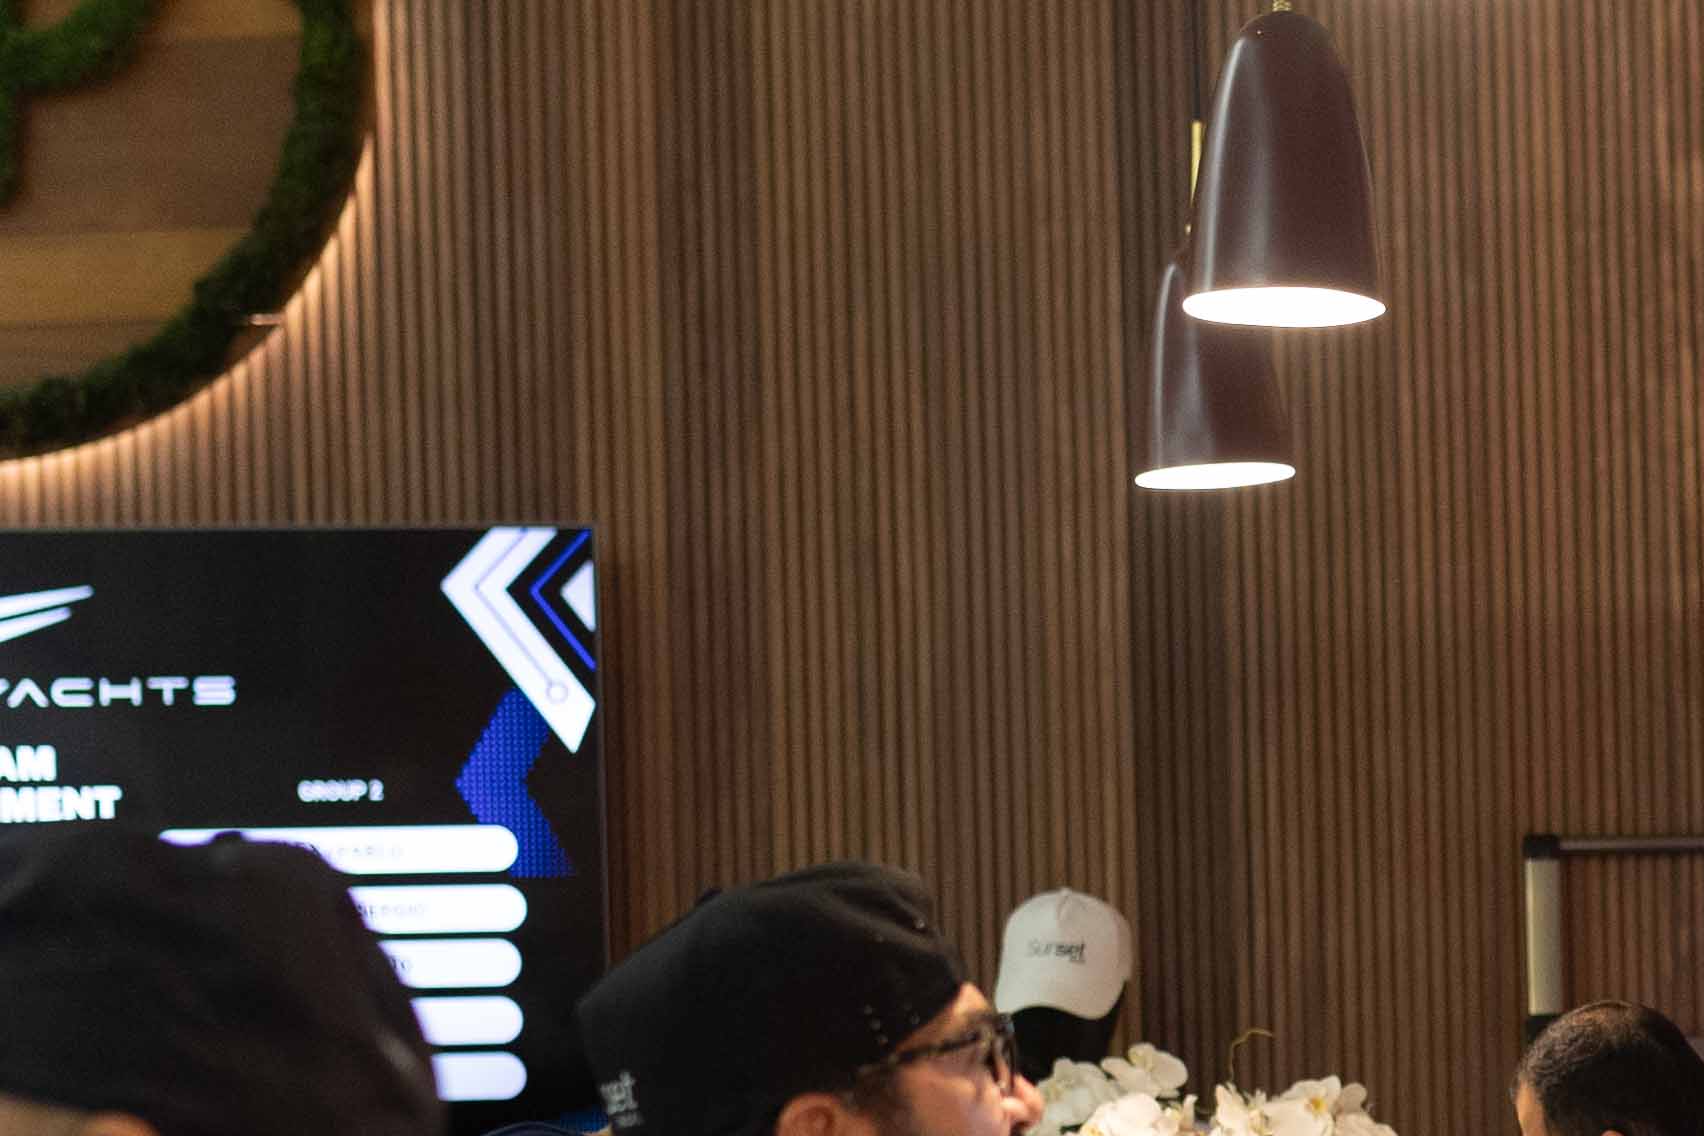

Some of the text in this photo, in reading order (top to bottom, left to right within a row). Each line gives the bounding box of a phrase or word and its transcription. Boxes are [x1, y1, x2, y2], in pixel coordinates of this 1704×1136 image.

[0, 674, 237, 709] ACHTS
[297, 779, 384, 802] GROUP 2
